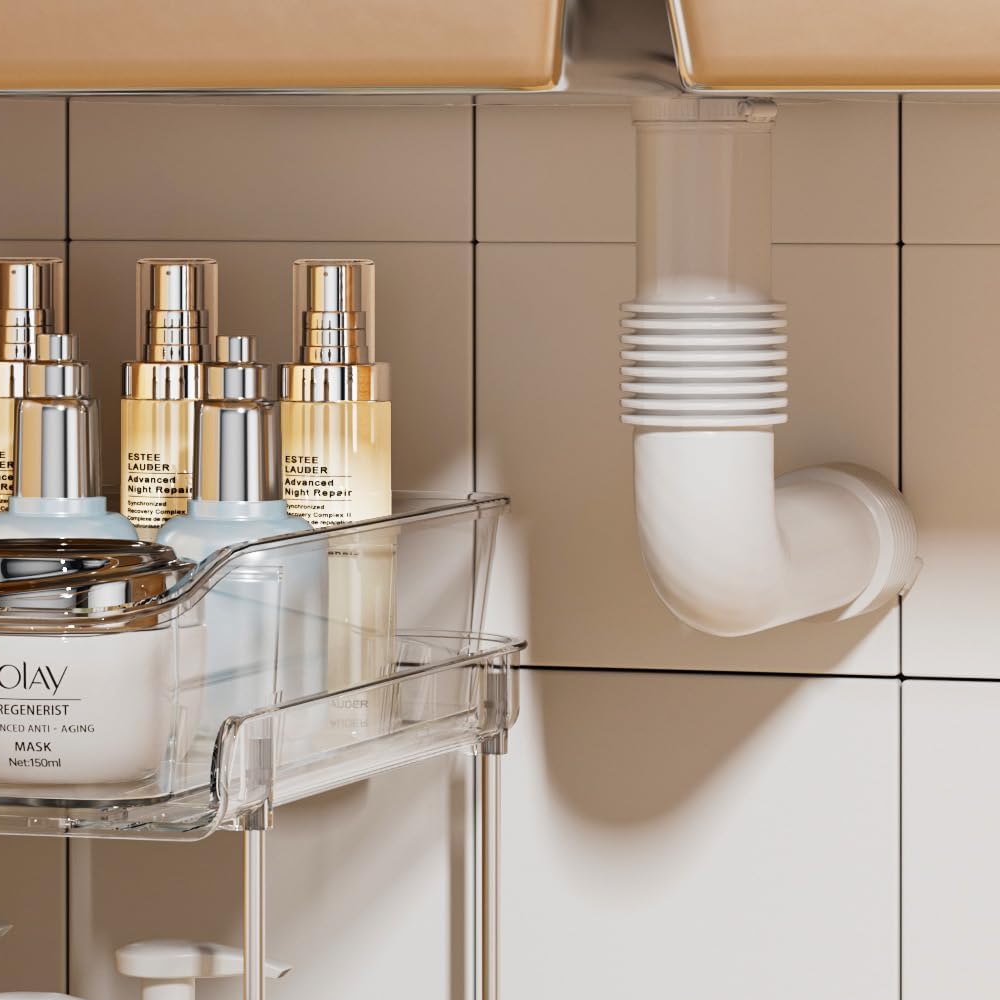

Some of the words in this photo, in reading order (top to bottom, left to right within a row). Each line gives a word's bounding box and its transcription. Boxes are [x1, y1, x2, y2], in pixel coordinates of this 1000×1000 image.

[128, 452, 160, 461] ESTEE
[285, 455, 318, 463] ESTEE
[128, 463, 170, 471] LAUDER
[285, 466, 328, 474] LAUDER
[128, 474, 176, 483] Advanced
[285, 478, 334, 487] Advanced
[128, 485, 151, 494] Night
[155, 486, 193, 495] Repair
[285, 488, 309, 497] Night
[313, 489, 353, 498] Repair
[155, 508, 186, 516] Complex
[27, 724, 50, 733] ANTI
[61, 724, 95, 734] AGING
[14, 741, 52, 752] MASK
[8, 757, 62, 768] Net:150ml
